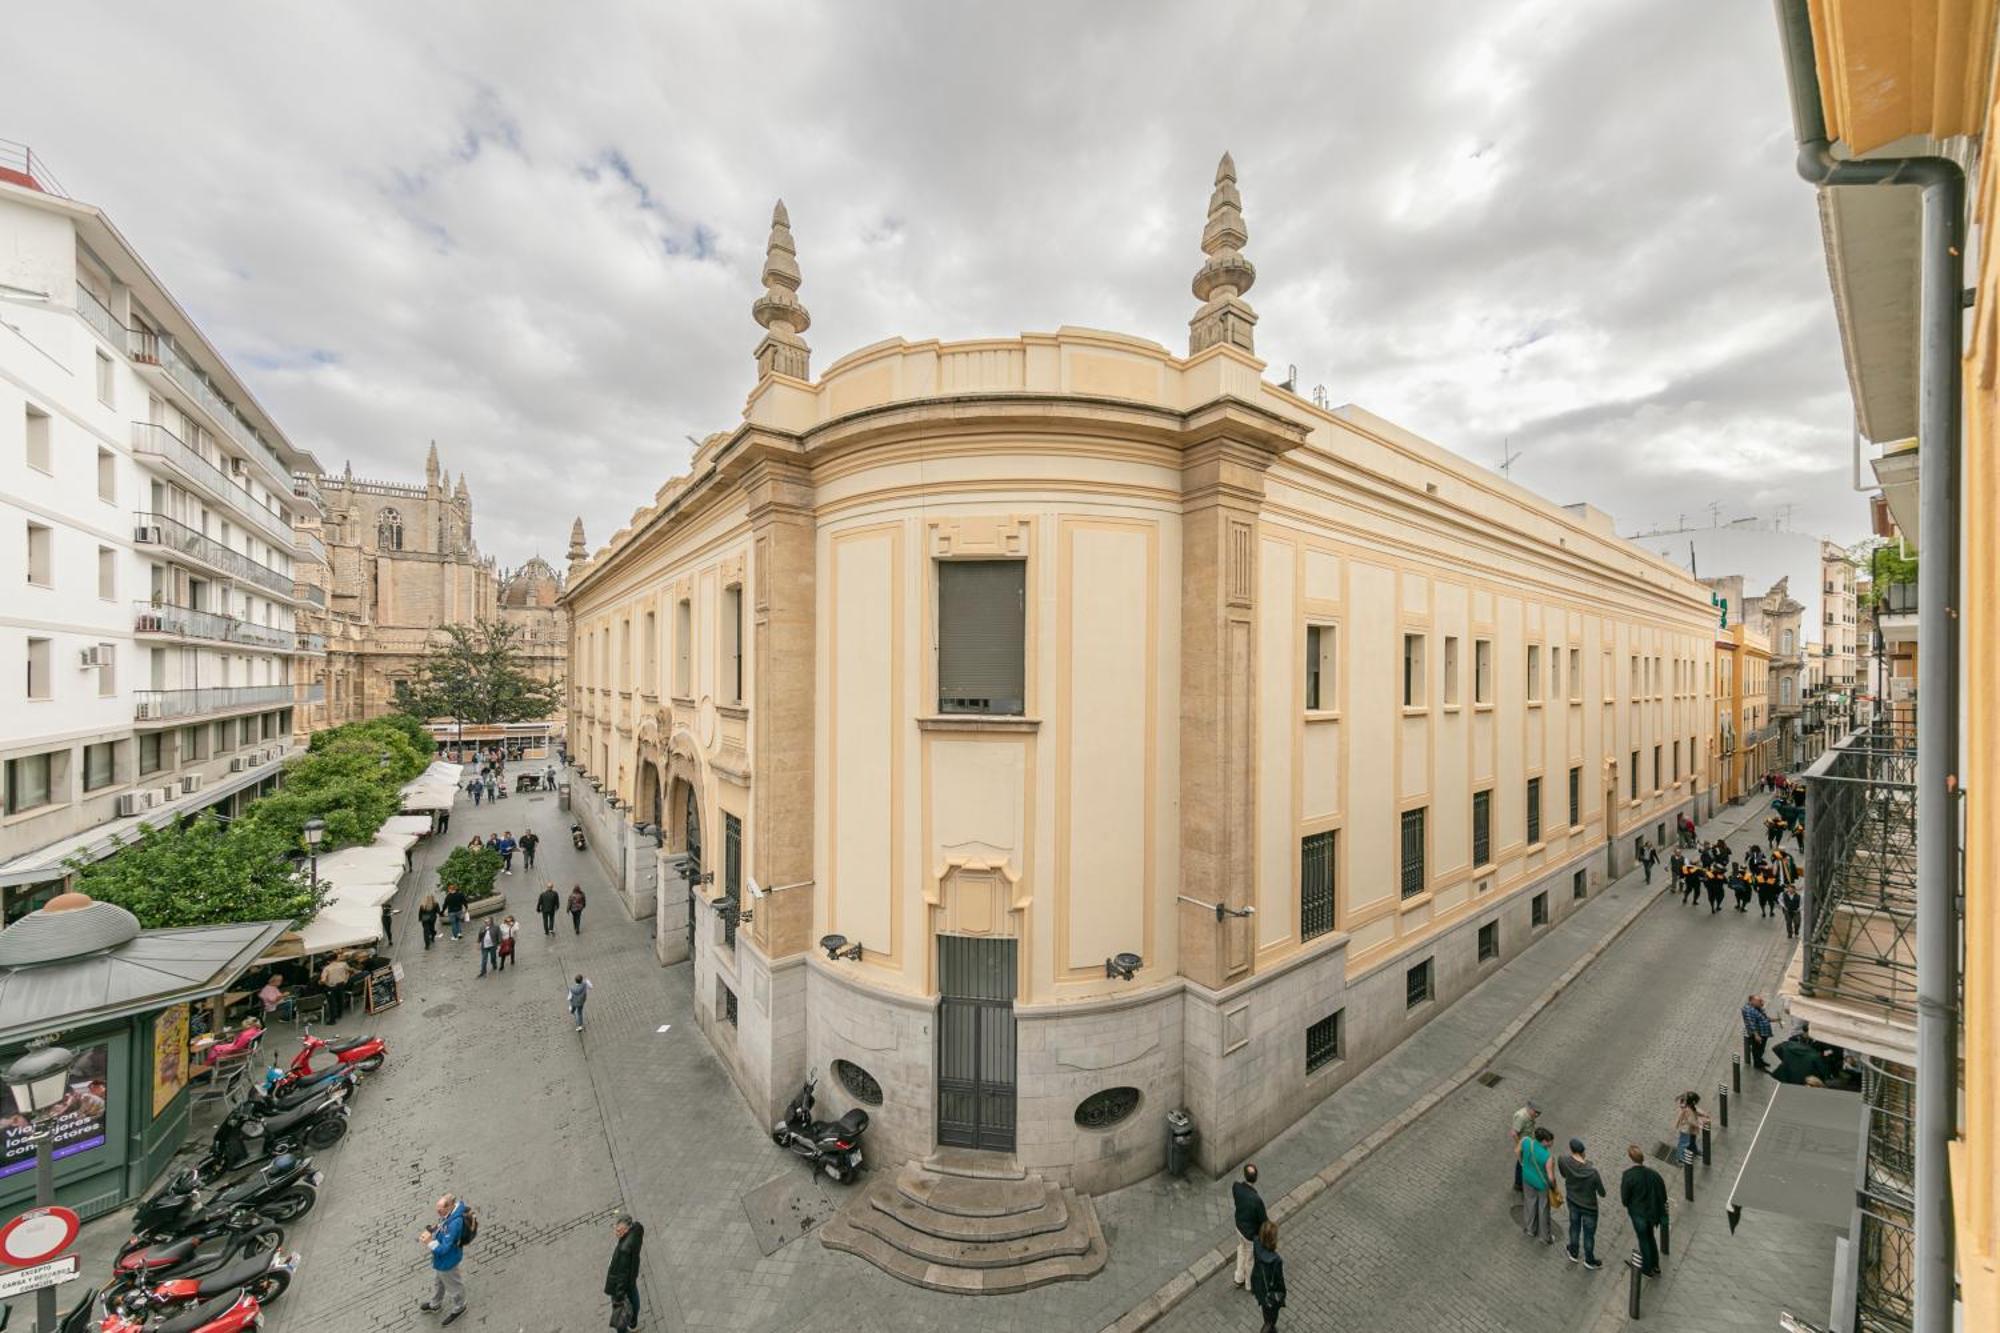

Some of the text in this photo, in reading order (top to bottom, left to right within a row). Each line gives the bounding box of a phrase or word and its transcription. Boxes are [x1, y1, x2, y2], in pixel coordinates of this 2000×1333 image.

[6, 1121, 37, 1138] Viaj
[6, 1123, 100, 1157] conctores
[6, 1136, 29, 1149] los
[21, 1265, 51, 1277] EXCEPTO
[2, 1279, 26, 1289] CARGA
